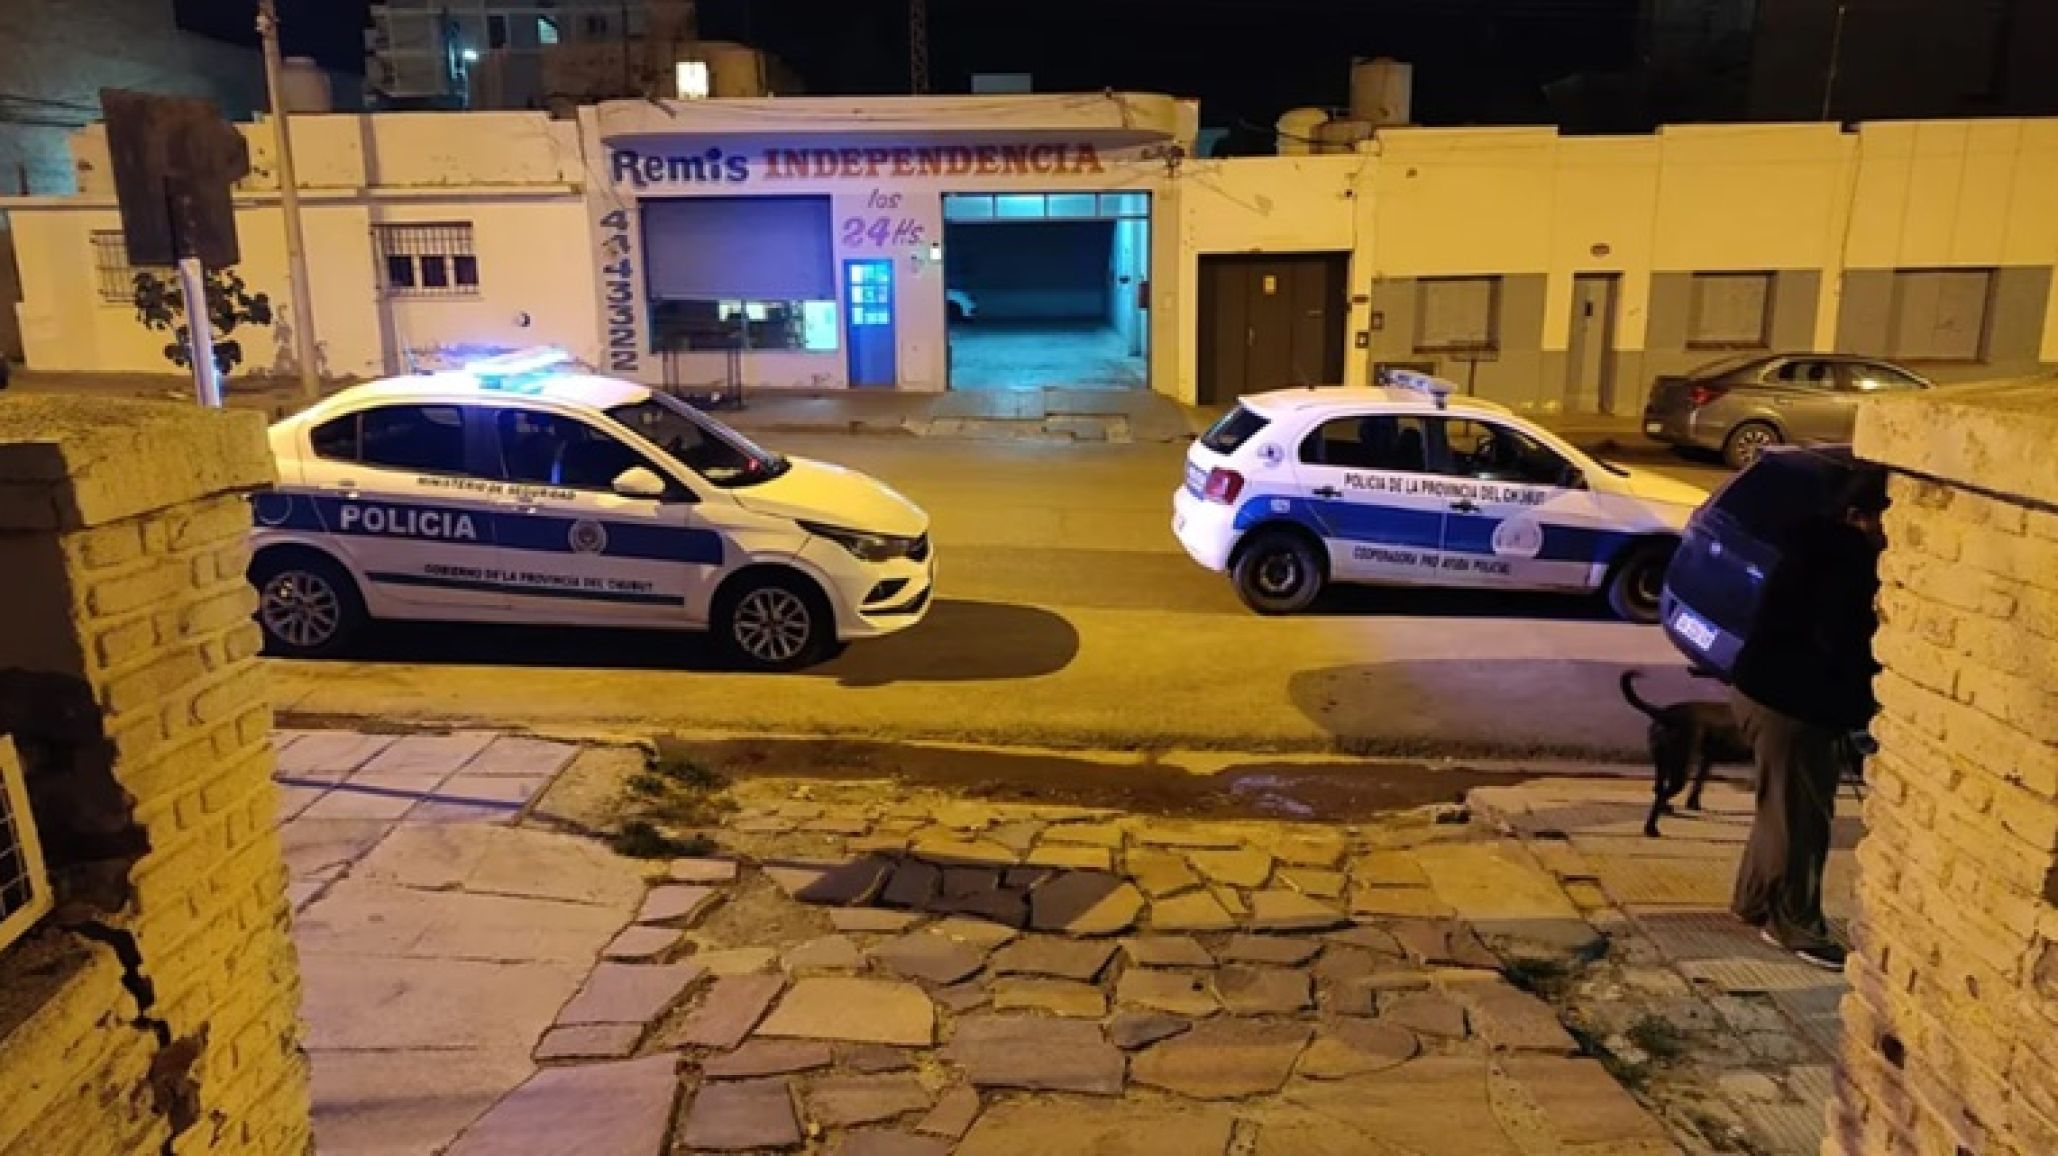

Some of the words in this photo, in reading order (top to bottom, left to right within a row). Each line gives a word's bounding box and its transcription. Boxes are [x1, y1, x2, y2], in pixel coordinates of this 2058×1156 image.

[612, 147, 749, 188] Remis
[762, 142, 1105, 179] INDEPENDENCIA
[843, 216, 891, 247] 24
[340, 504, 477, 540] POLICIA
